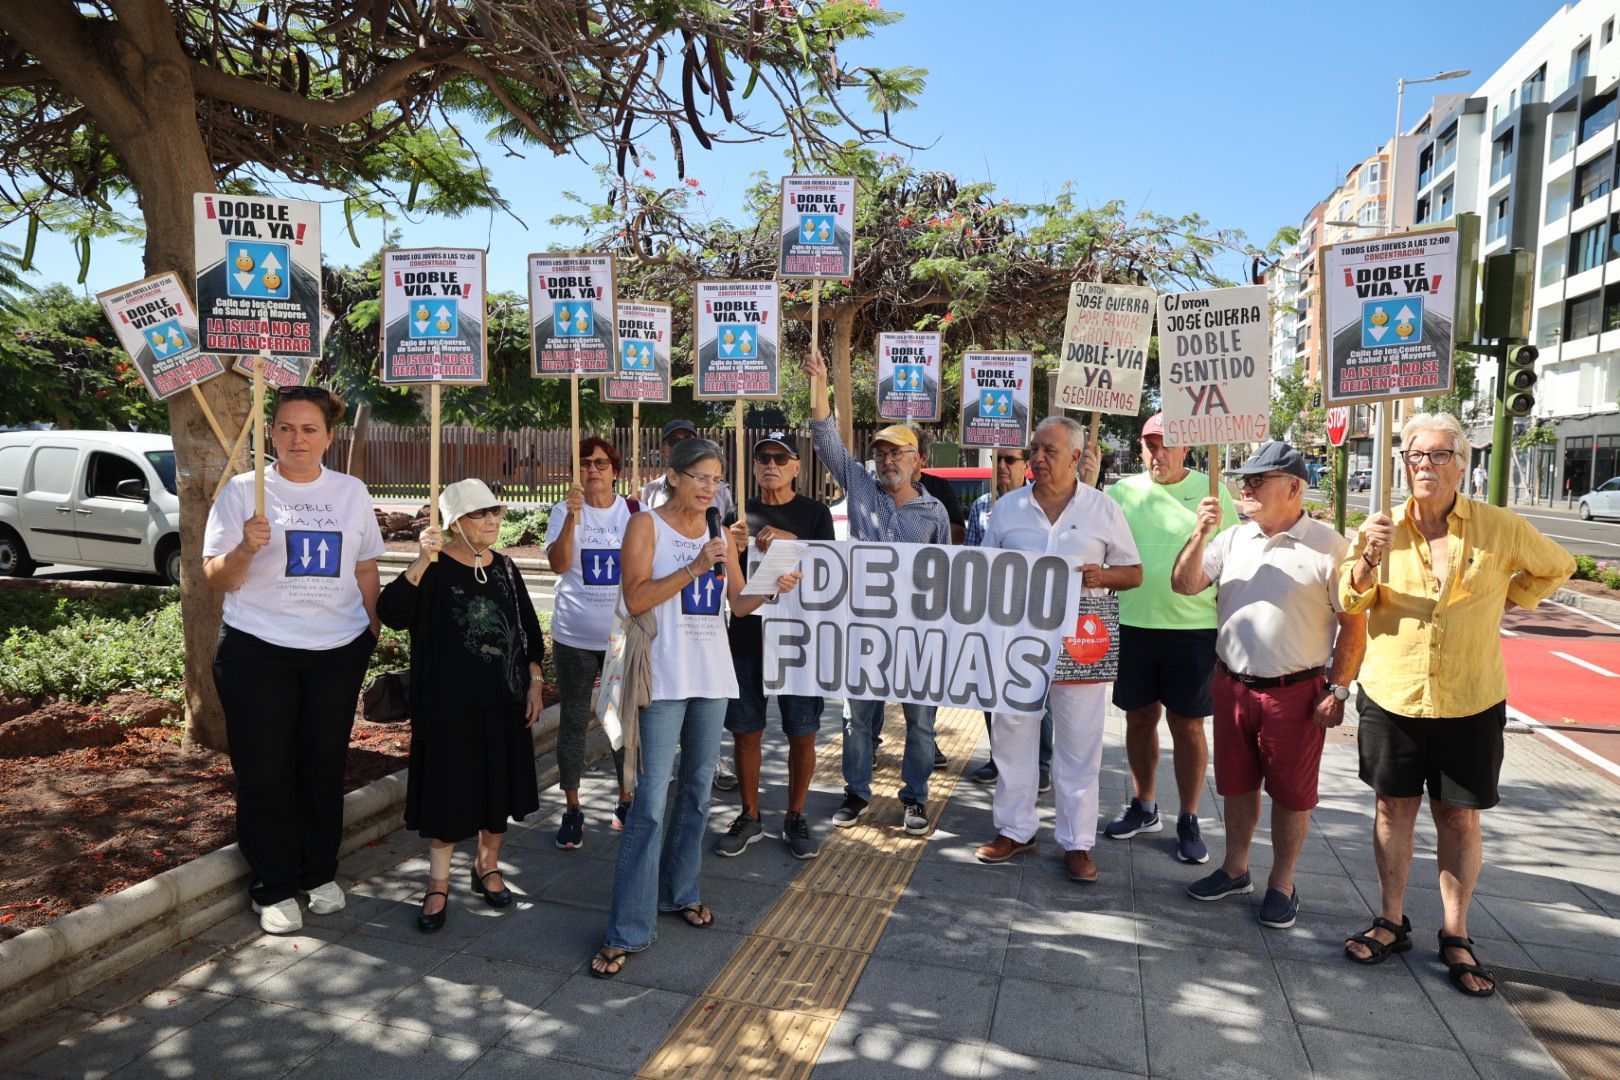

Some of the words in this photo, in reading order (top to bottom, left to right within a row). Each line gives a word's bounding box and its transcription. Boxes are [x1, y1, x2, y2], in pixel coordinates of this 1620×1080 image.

[268, 223, 306, 246] YA!
[1341, 246, 1365, 255] TODOS
[1382, 242, 1406, 251] JUEVES
[1414, 239, 1427, 247] LAS
[1430, 236, 1450, 245] 12:00
[1364, 248, 1425, 261] CONCENTRACIÓN
[441, 284, 471, 298] YA!
[579, 287, 603, 300] YA!
[1404, 275, 1442, 294] YA!
[216, 298, 238, 307] Calle
[240, 300, 250, 308] de
[252, 300, 265, 309] los
[267, 301, 301, 310] Centros
[225, 307, 249, 316] Salud
[258, 309, 268, 317] de
[270, 310, 307, 319] Mayores
[1106, 296, 1149, 314] GUERRA
[744, 310, 768, 324] YA!
[1103, 312, 1139, 330] FAVOR
[1205, 306, 1260, 328] GUERRA
[207, 318, 224, 332] LA
[226, 319, 269, 335] ISLETA
[272, 321, 290, 336] NO
[293, 322, 310, 337] SE
[207, 334, 241, 349] DEJA
[242, 335, 310, 352] ENCERRAR
[1177, 330, 1242, 357] DOBLE
[1399, 344, 1432, 354] Centros
[392, 354, 406, 365] LA
[444, 353, 459, 364] NO
[461, 353, 473, 364] SE
[1358, 356, 1381, 364] Salud
[1402, 351, 1436, 360] Mayores
[420, 365, 473, 375] ENCERRAR
[1084, 367, 1113, 390] YA
[1169, 354, 1255, 384] SENTIDO
[1340, 367, 1356, 379] LA
[1358, 364, 1399, 378] ISLETA
[1402, 362, 1419, 375] NO
[1423, 360, 1439, 373] SE
[1340, 379, 1370, 393] DEJA
[1372, 374, 1438, 390] ENCERRAR
[1328, 407, 1347, 428] STOP
[1169, 414, 1266, 444] SEGUIREMOS
[800, 543, 900, 619] DE
[912, 546, 1069, 631] 9000
[763, 618, 1051, 712] FIRMAS
